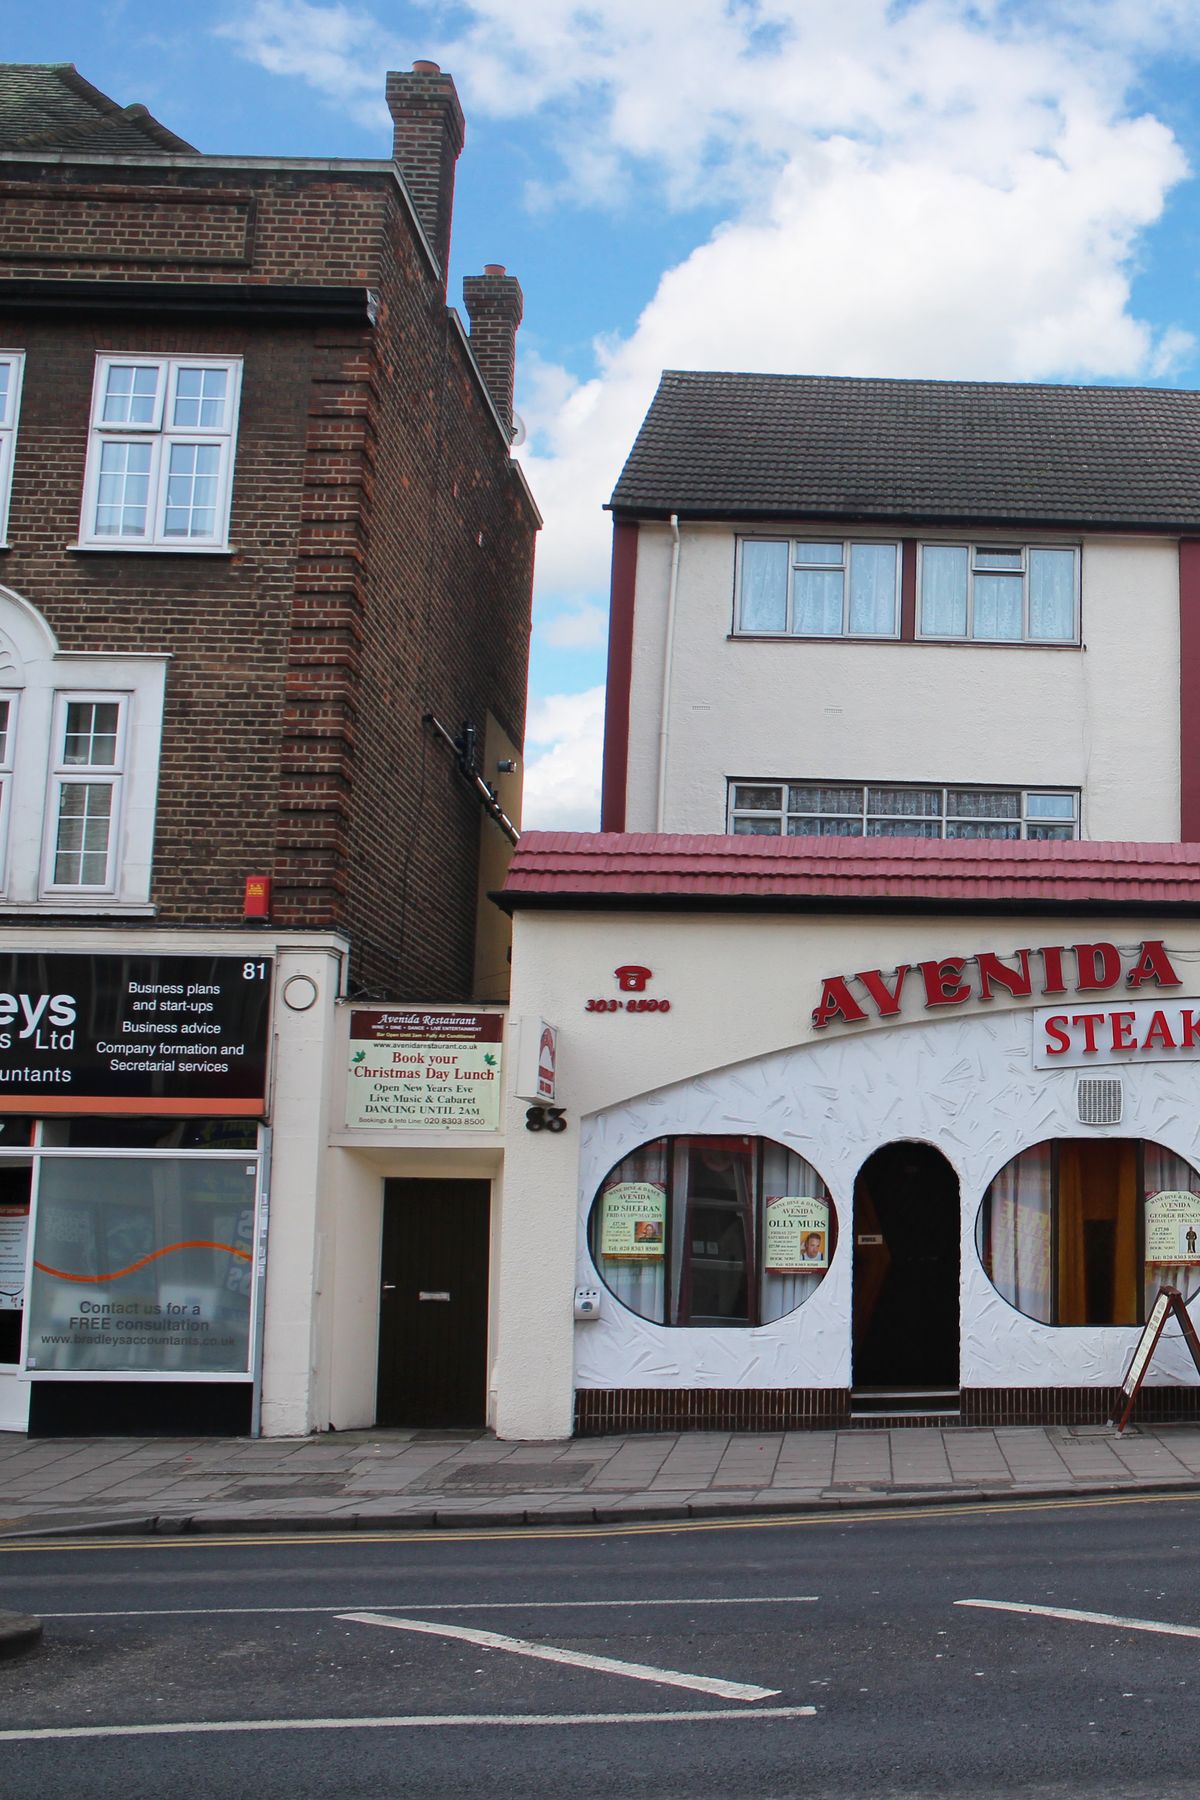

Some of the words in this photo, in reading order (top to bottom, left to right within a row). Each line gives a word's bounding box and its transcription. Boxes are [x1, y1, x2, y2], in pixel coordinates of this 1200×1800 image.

[243, 962, 265, 980] 81
[128, 982, 183, 994] Business
[187, 983, 221, 996] plans
[812, 940, 1183, 1029] AVENIDA
[133, 1000, 156, 1011] and
[160, 1001, 214, 1014] start-ups
[626, 999, 670, 1013] 8500
[378, 1014, 420, 1024] Avenida
[423, 1015, 476, 1025] Restaurant
[122, 1021, 177, 1033] Business
[181, 1022, 221, 1034] advice
[35, 1029, 75, 1050] Ltd
[373, 1042, 477, 1050] www.avenidarestaurant.co.uk
[96, 1041, 156, 1056] Company
[159, 1043, 217, 1055] formation
[220, 1044, 245, 1055] and
[110, 1059, 175, 1072] Secretarial
[178, 1061, 228, 1072] services
[392, 1051, 425, 1064] Book
[428, 1055, 458, 1066] your
[354, 1066, 421, 1079] Christmas
[425, 1067, 450, 1082] Day
[454, 1068, 494, 1080] Lunch
[374, 1083, 400, 1093] Open
[403, 1084, 422, 1092] New
[426, 1084, 453, 1093] Years
[456, 1085, 473, 1093] Eve
[369, 1094, 390, 1103] Live
[392, 1094, 422, 1104] Music
[425, 1095, 433, 1103] &
[437, 1095, 476, 1104] Cabaret
[365, 1104, 416, 1114] DANCING
[419, 1106, 456, 1115] UNTIL
[458, 1106, 480, 1115] 2AM
[358, 1117, 387, 1125] Bookings
[463, 1118, 485, 1126] 8500
[526, 1107, 567, 1133] 83
[79, 1301, 139, 1314] Contact
[143, 1303, 161, 1314] us
[166, 1303, 188, 1315] for
[192, 1305, 201, 1315] a
[69, 1317, 111, 1330] FREE
[115, 1319, 209, 1331] consultation
[41, 1334, 235, 1347] www.bradleysaccountants.co.uk
